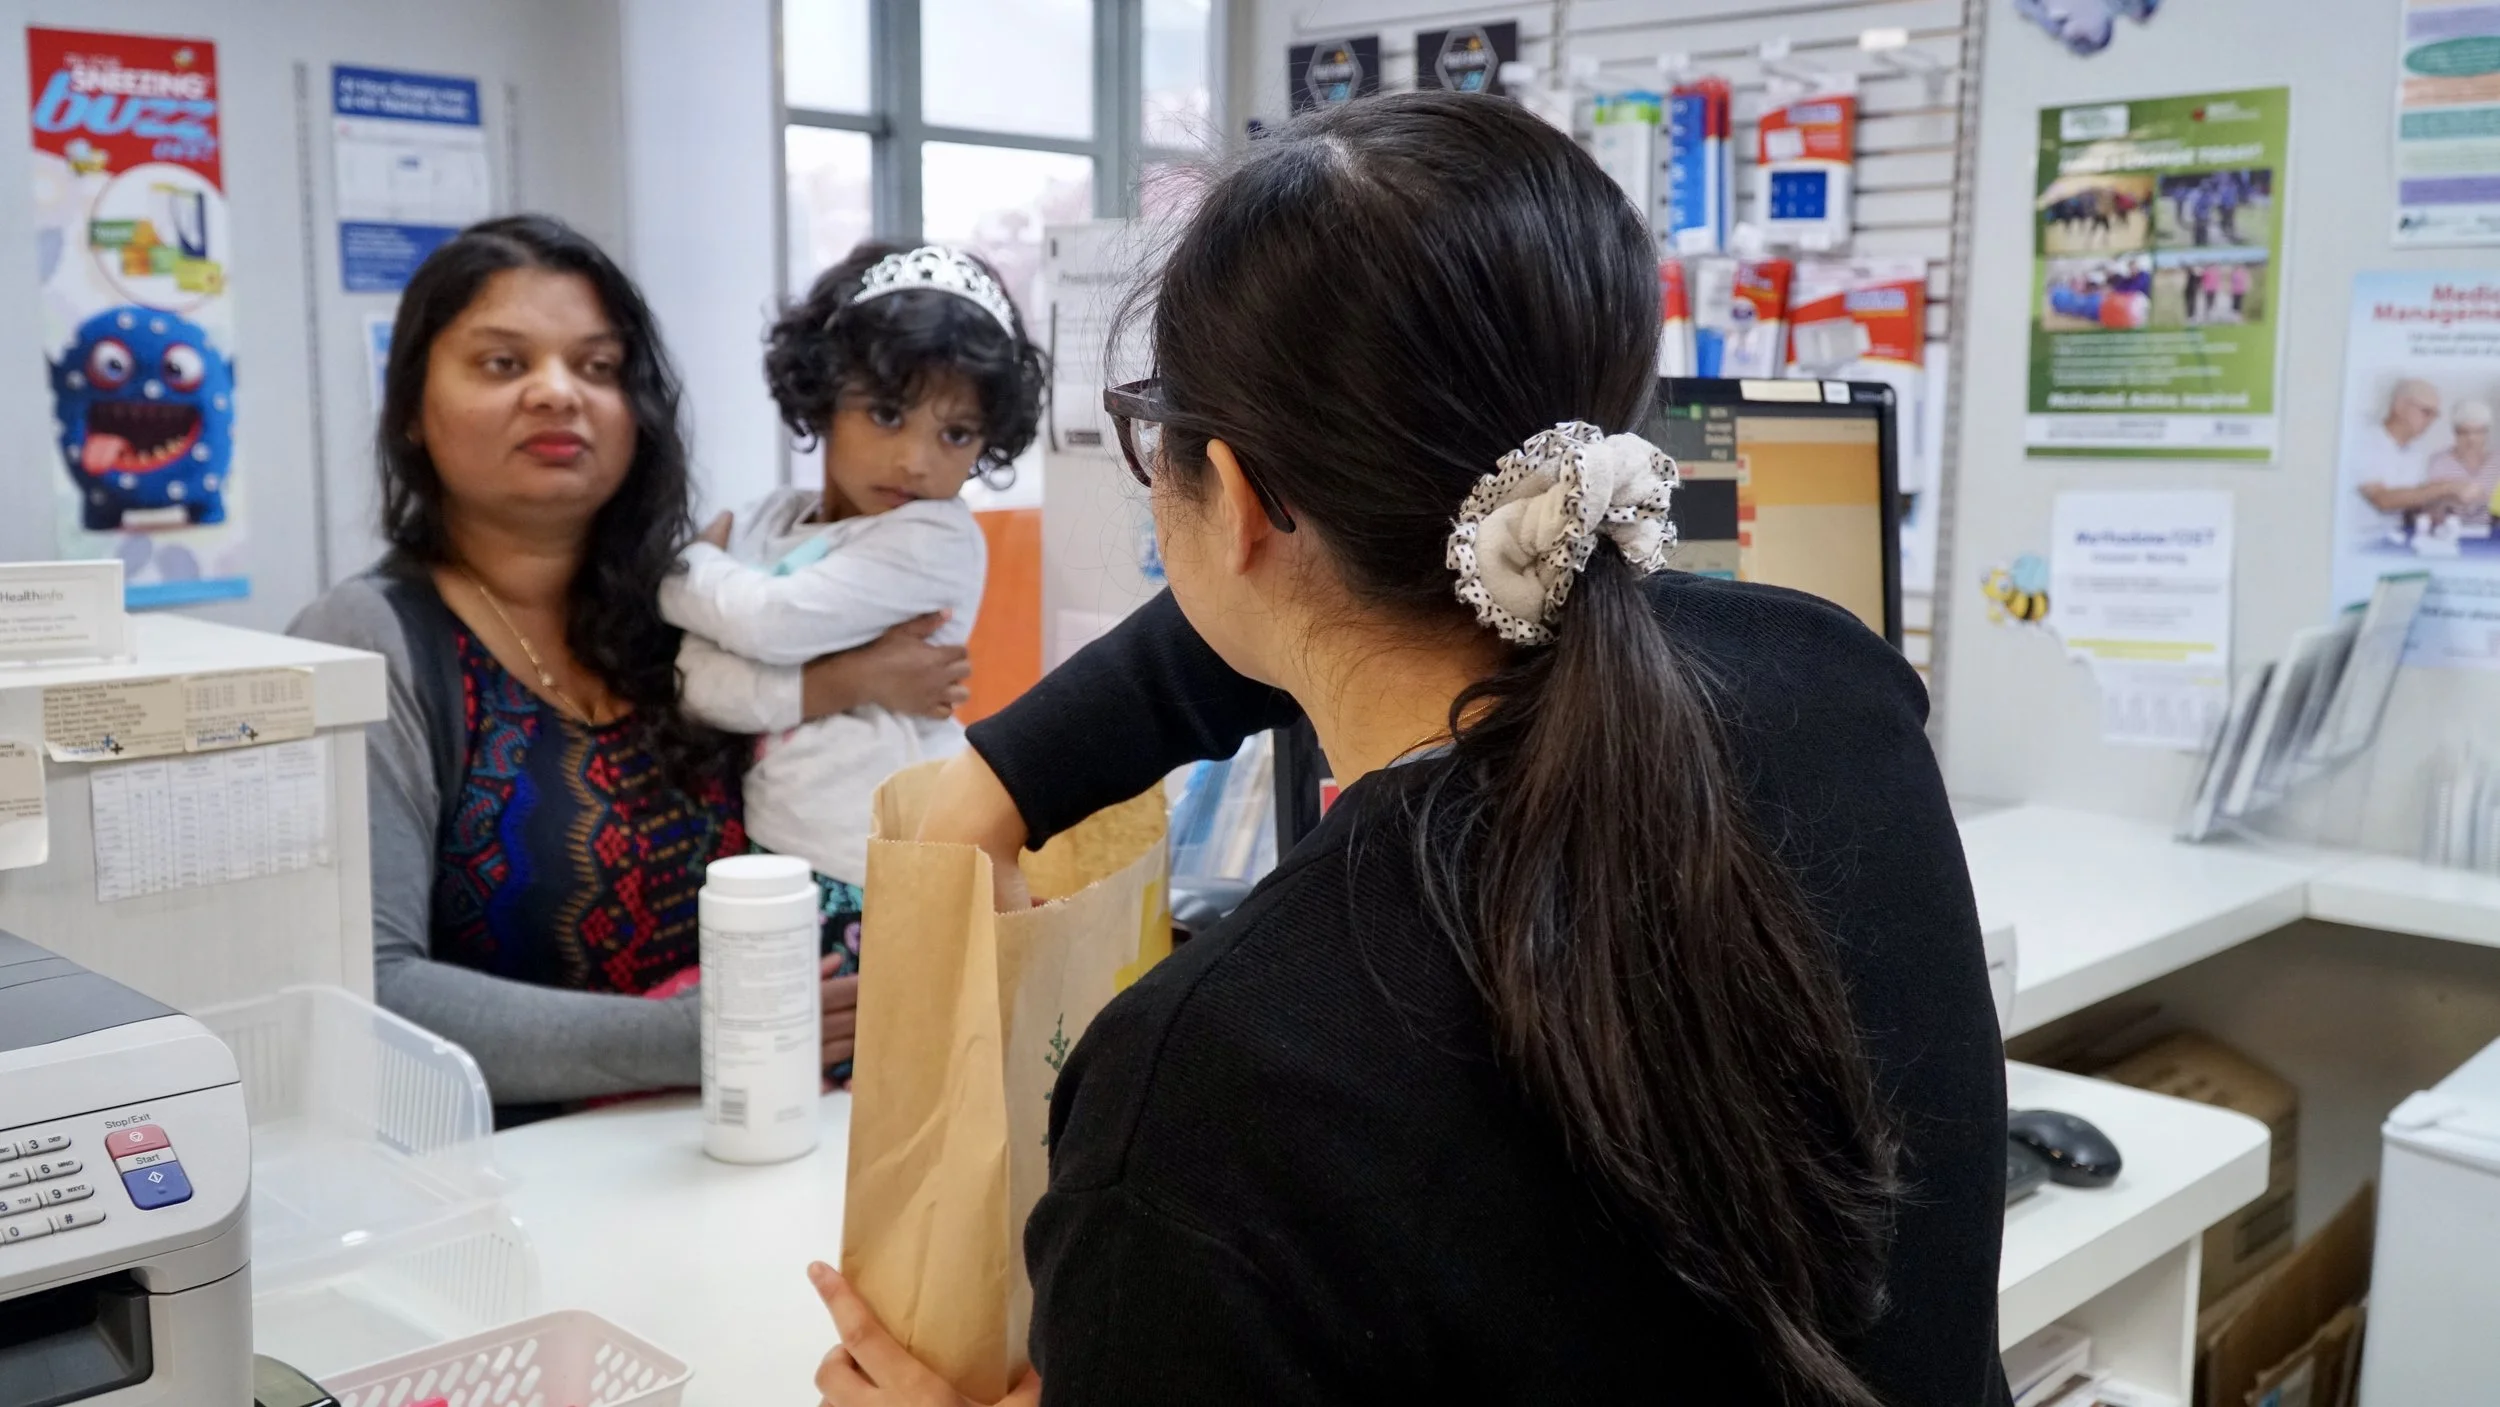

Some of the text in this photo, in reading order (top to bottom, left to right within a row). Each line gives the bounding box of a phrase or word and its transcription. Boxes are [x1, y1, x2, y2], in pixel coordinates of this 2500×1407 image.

[71, 65, 206, 100] SNEEZING
[34, 70, 214, 134] buzz
[105, 1113, 151, 1129] Stop/Exit
[29, 1140, 39, 1149] 3
[135, 1153, 161, 1164] Start
[41, 1160, 74, 1174] 6 MNO
[52, 1185, 86, 1199] 9 WXYZ
[0, 1201, 8, 1211] 8
[64, 1214, 74, 1224] #
[9, 1226, 19, 1237] 0
